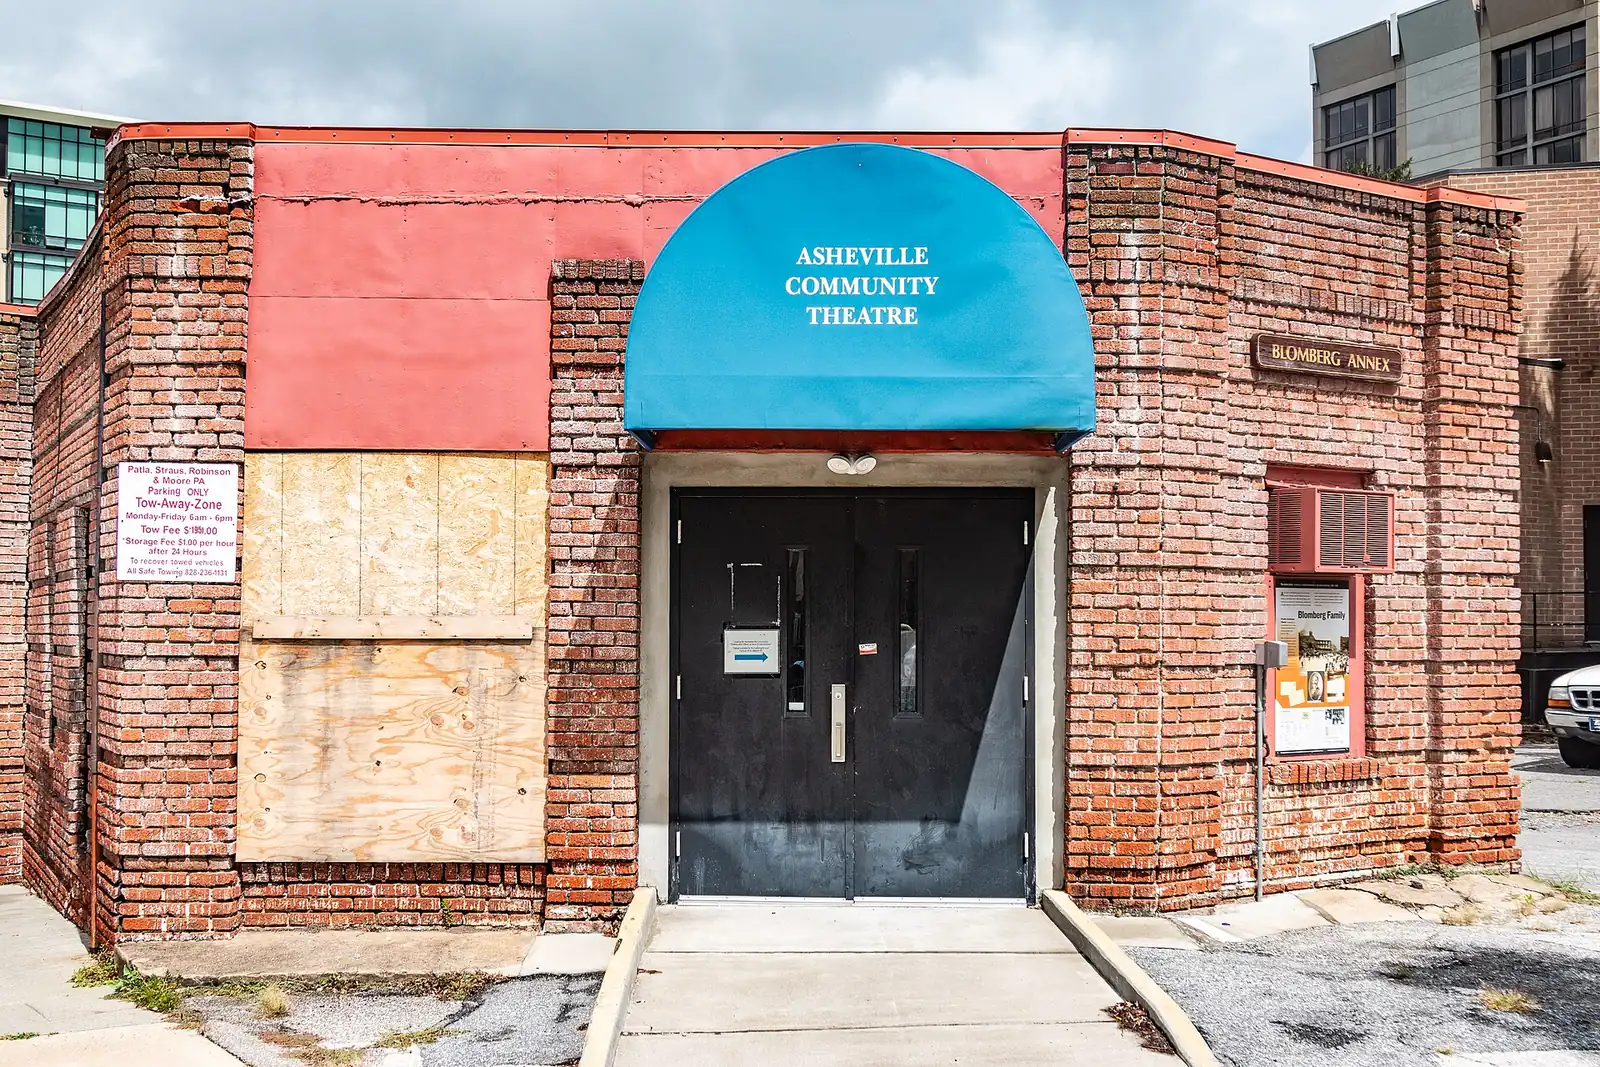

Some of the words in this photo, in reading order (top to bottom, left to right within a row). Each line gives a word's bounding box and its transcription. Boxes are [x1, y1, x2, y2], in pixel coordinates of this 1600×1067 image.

[796, 247, 929, 265] ASHEVILLE
[785, 277, 939, 295] COMMUNITY
[806, 307, 918, 324] THEATRE
[1272, 344, 1340, 366] BLOMBERG
[1348, 354, 1390, 372] ANNEX
[189, 467, 230, 475] Robinson
[148, 487, 180, 496] Parking
[187, 488, 209, 496] ONLY
[136, 497, 222, 511] Tow-Away-Zone
[126, 512, 186, 522] Monday-Friday
[141, 525, 159, 533] Tow
[163, 526, 180, 534] Fee
[158, 568, 182, 576] Towing
[1298, 611, 1326, 620] Blomberg
[1327, 611, 1346, 620] Family
